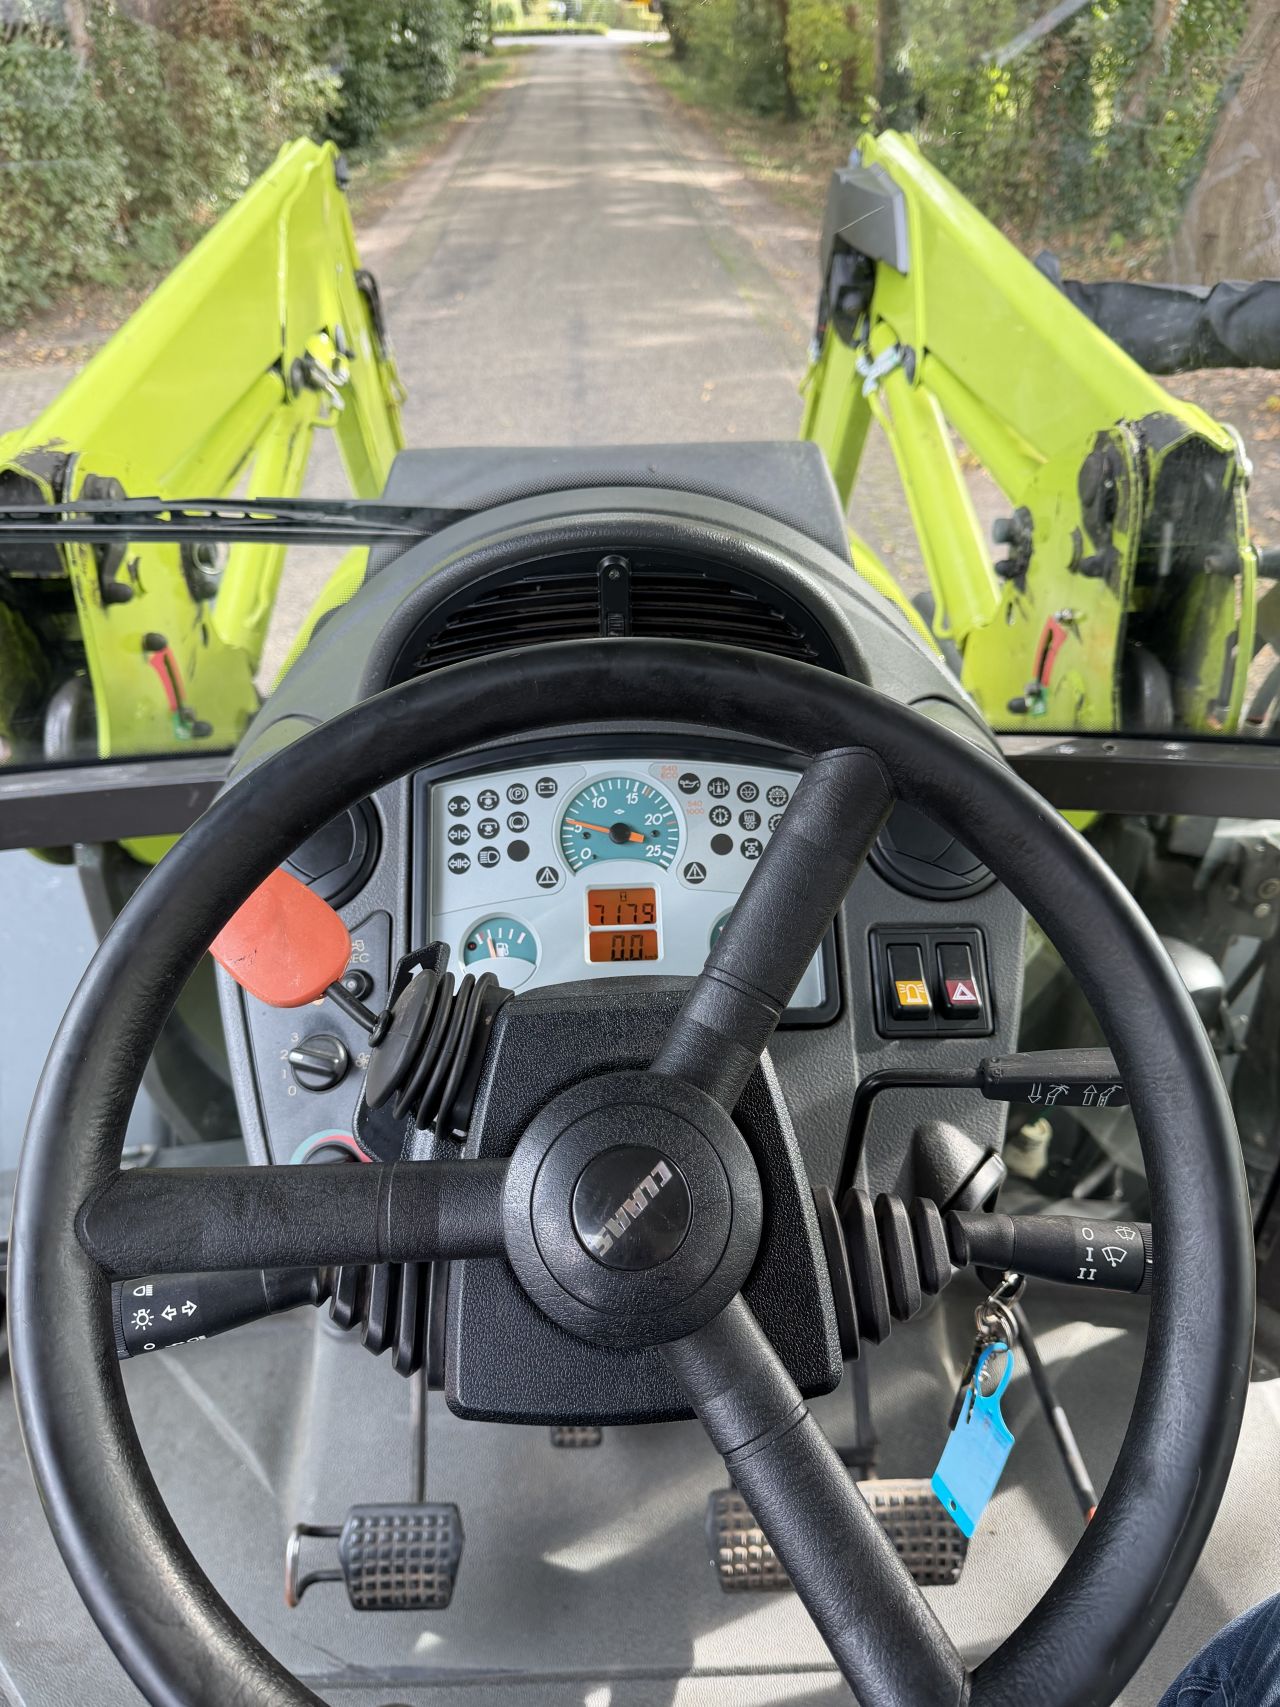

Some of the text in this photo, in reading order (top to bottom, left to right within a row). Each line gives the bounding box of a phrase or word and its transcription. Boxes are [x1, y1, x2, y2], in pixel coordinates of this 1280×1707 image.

[591, 796, 608, 809] 10
[626, 792, 639, 805] 15
[644, 813, 663, 826] 20
[573, 823, 583, 833] 5
[580, 847, 592, 860] 0
[645, 844, 661, 857] 25
[593, 903, 654, 924] 7179
[611, 935, 643, 961] 0.0
[350, 952, 369, 964] EC
[290, 1031, 299, 1042] 3
[280, 1049, 289, 1060] 2
[595, 1160, 673, 1257] CLAAS
